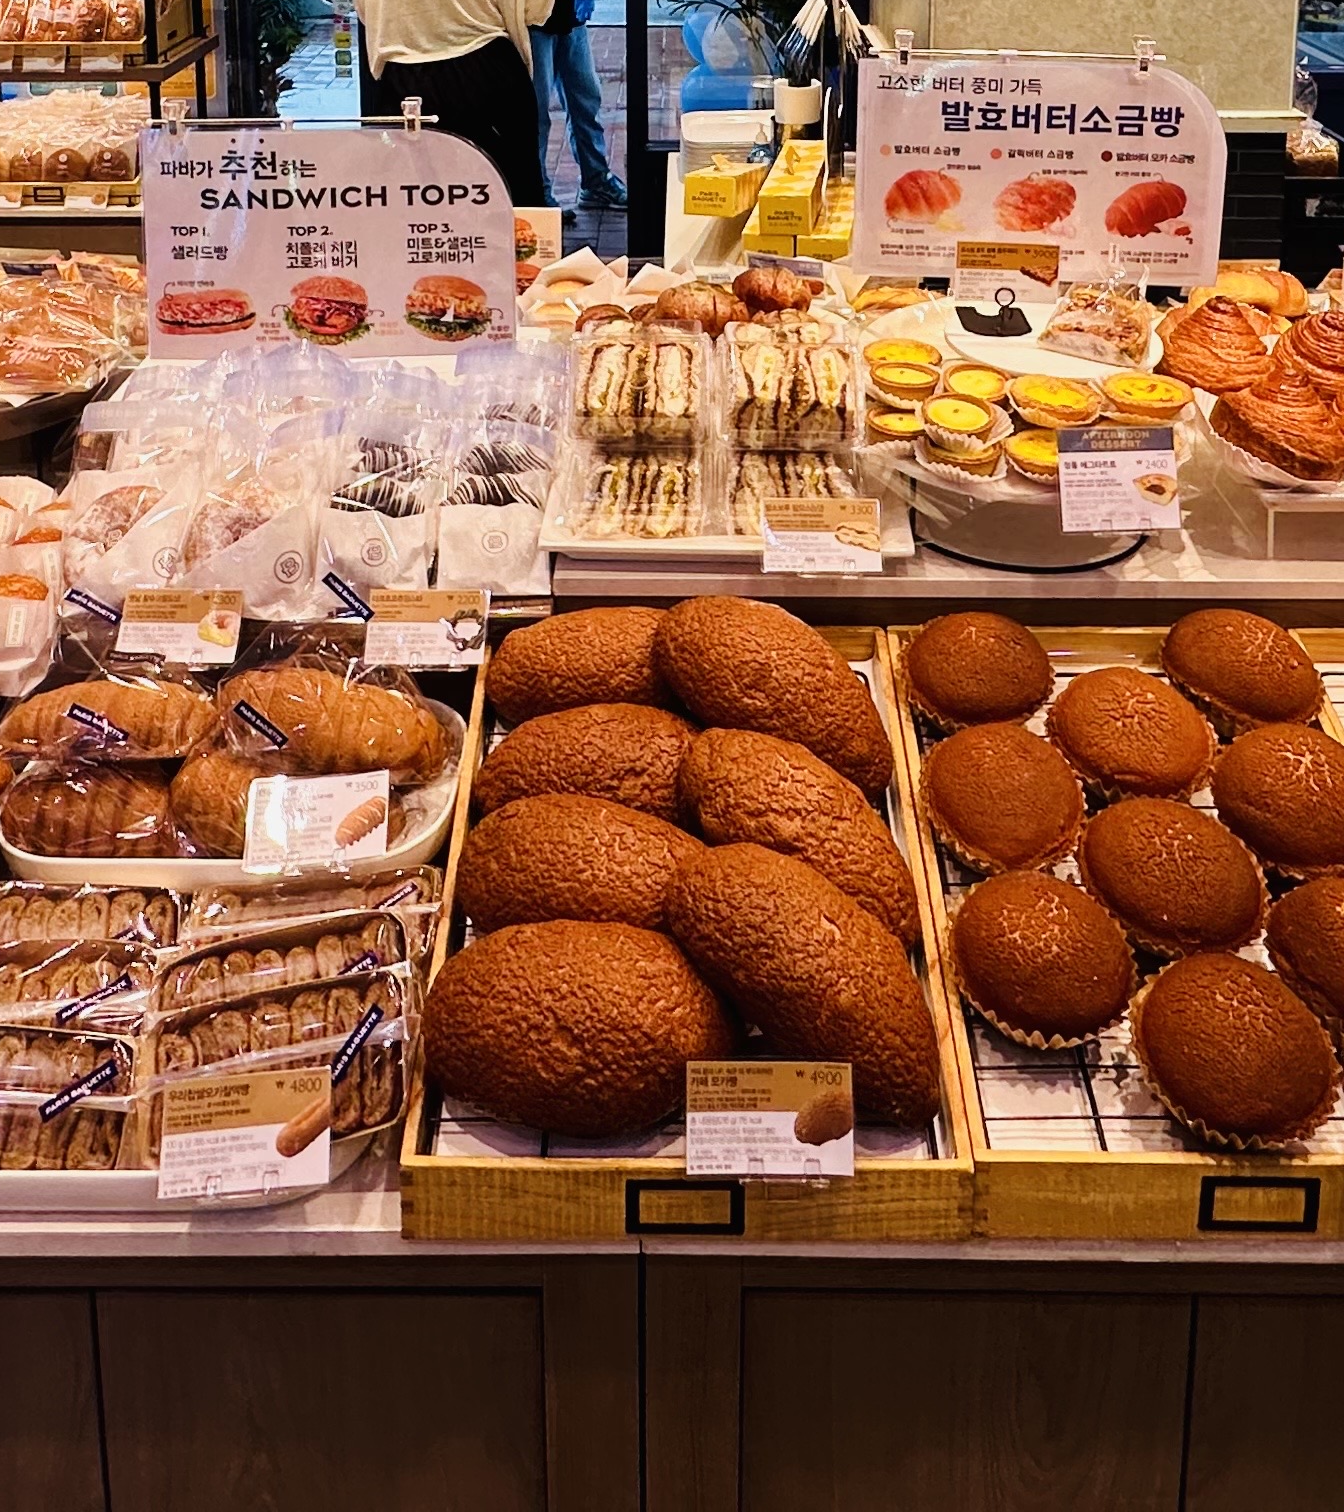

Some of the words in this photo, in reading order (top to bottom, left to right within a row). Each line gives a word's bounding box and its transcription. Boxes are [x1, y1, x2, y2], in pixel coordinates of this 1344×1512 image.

[931, 75, 965, 94] 버터
[970, 76, 1004, 95] 풍미
[1009, 77, 1043, 96] 가득
[940, 100, 1185, 138] 발효버터소금빵
[160, 160, 214, 179] 파바가
[218, 149, 318, 181] 추천하는
[200, 184, 388, 210] SANDWICH
[400, 183, 490, 207] TOP3
[170, 225, 199, 237] TOP
[287, 226, 317, 237] TOP
[408, 223, 436, 234] TOP
[330, 239, 358, 256] 치킨
[407, 236, 488, 251] 미트&샐러드
[171, 243, 229, 261] 샐러드빵
[407, 250, 475, 265] 고로케버거
[285, 255, 327, 270] 고로케
[331, 255, 358, 269] 버거
[1082, 430, 1150, 440] AFTERNOON
[1091, 439, 1142, 448] DESSERT
[290, 1077, 322, 1093] 4800
[809, 1070, 844, 1086] 4900
[45, 1095, 70, 1115] PARIS
